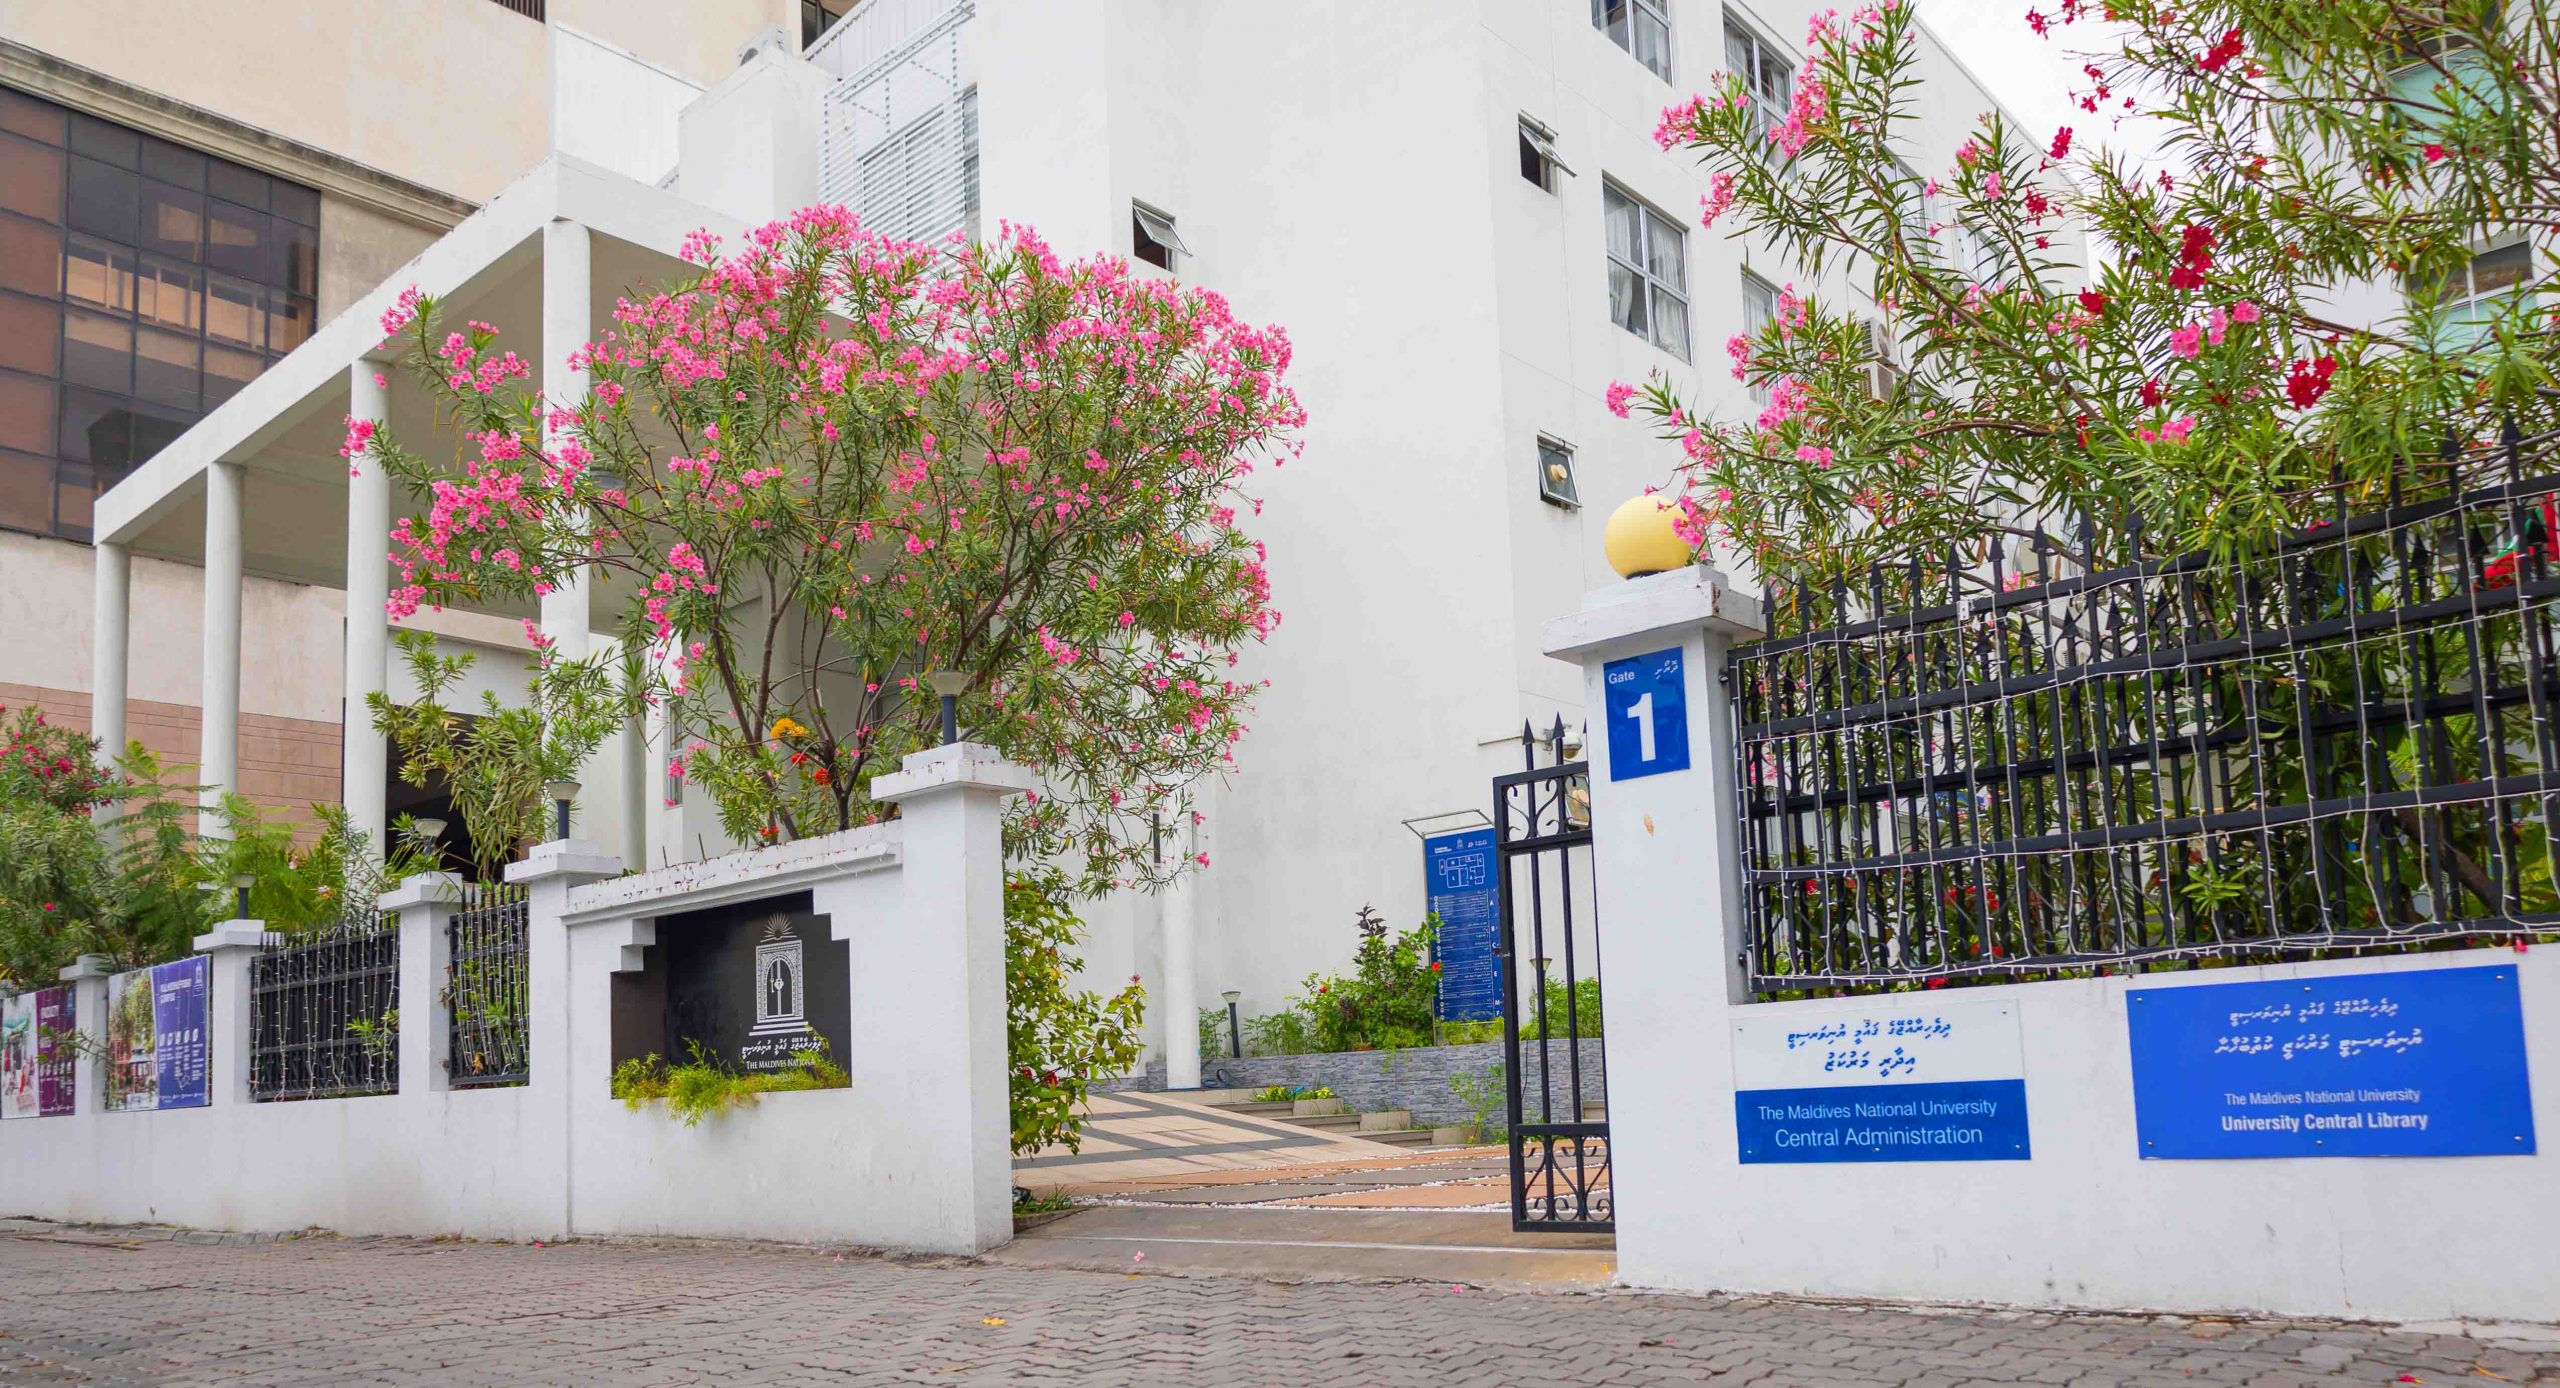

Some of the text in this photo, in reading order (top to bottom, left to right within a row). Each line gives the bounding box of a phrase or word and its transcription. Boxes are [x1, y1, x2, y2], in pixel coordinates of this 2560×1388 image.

[1609, 672, 1635, 684] Gate
[1627, 693, 1656, 761] 1
[2224, 1088, 2420, 1105] The Maldives National University
[1758, 1100, 1997, 1120] The Maldives National University
[2222, 1112, 2427, 1132] University Central Library
[1776, 1126, 1982, 1147] Central Administration
